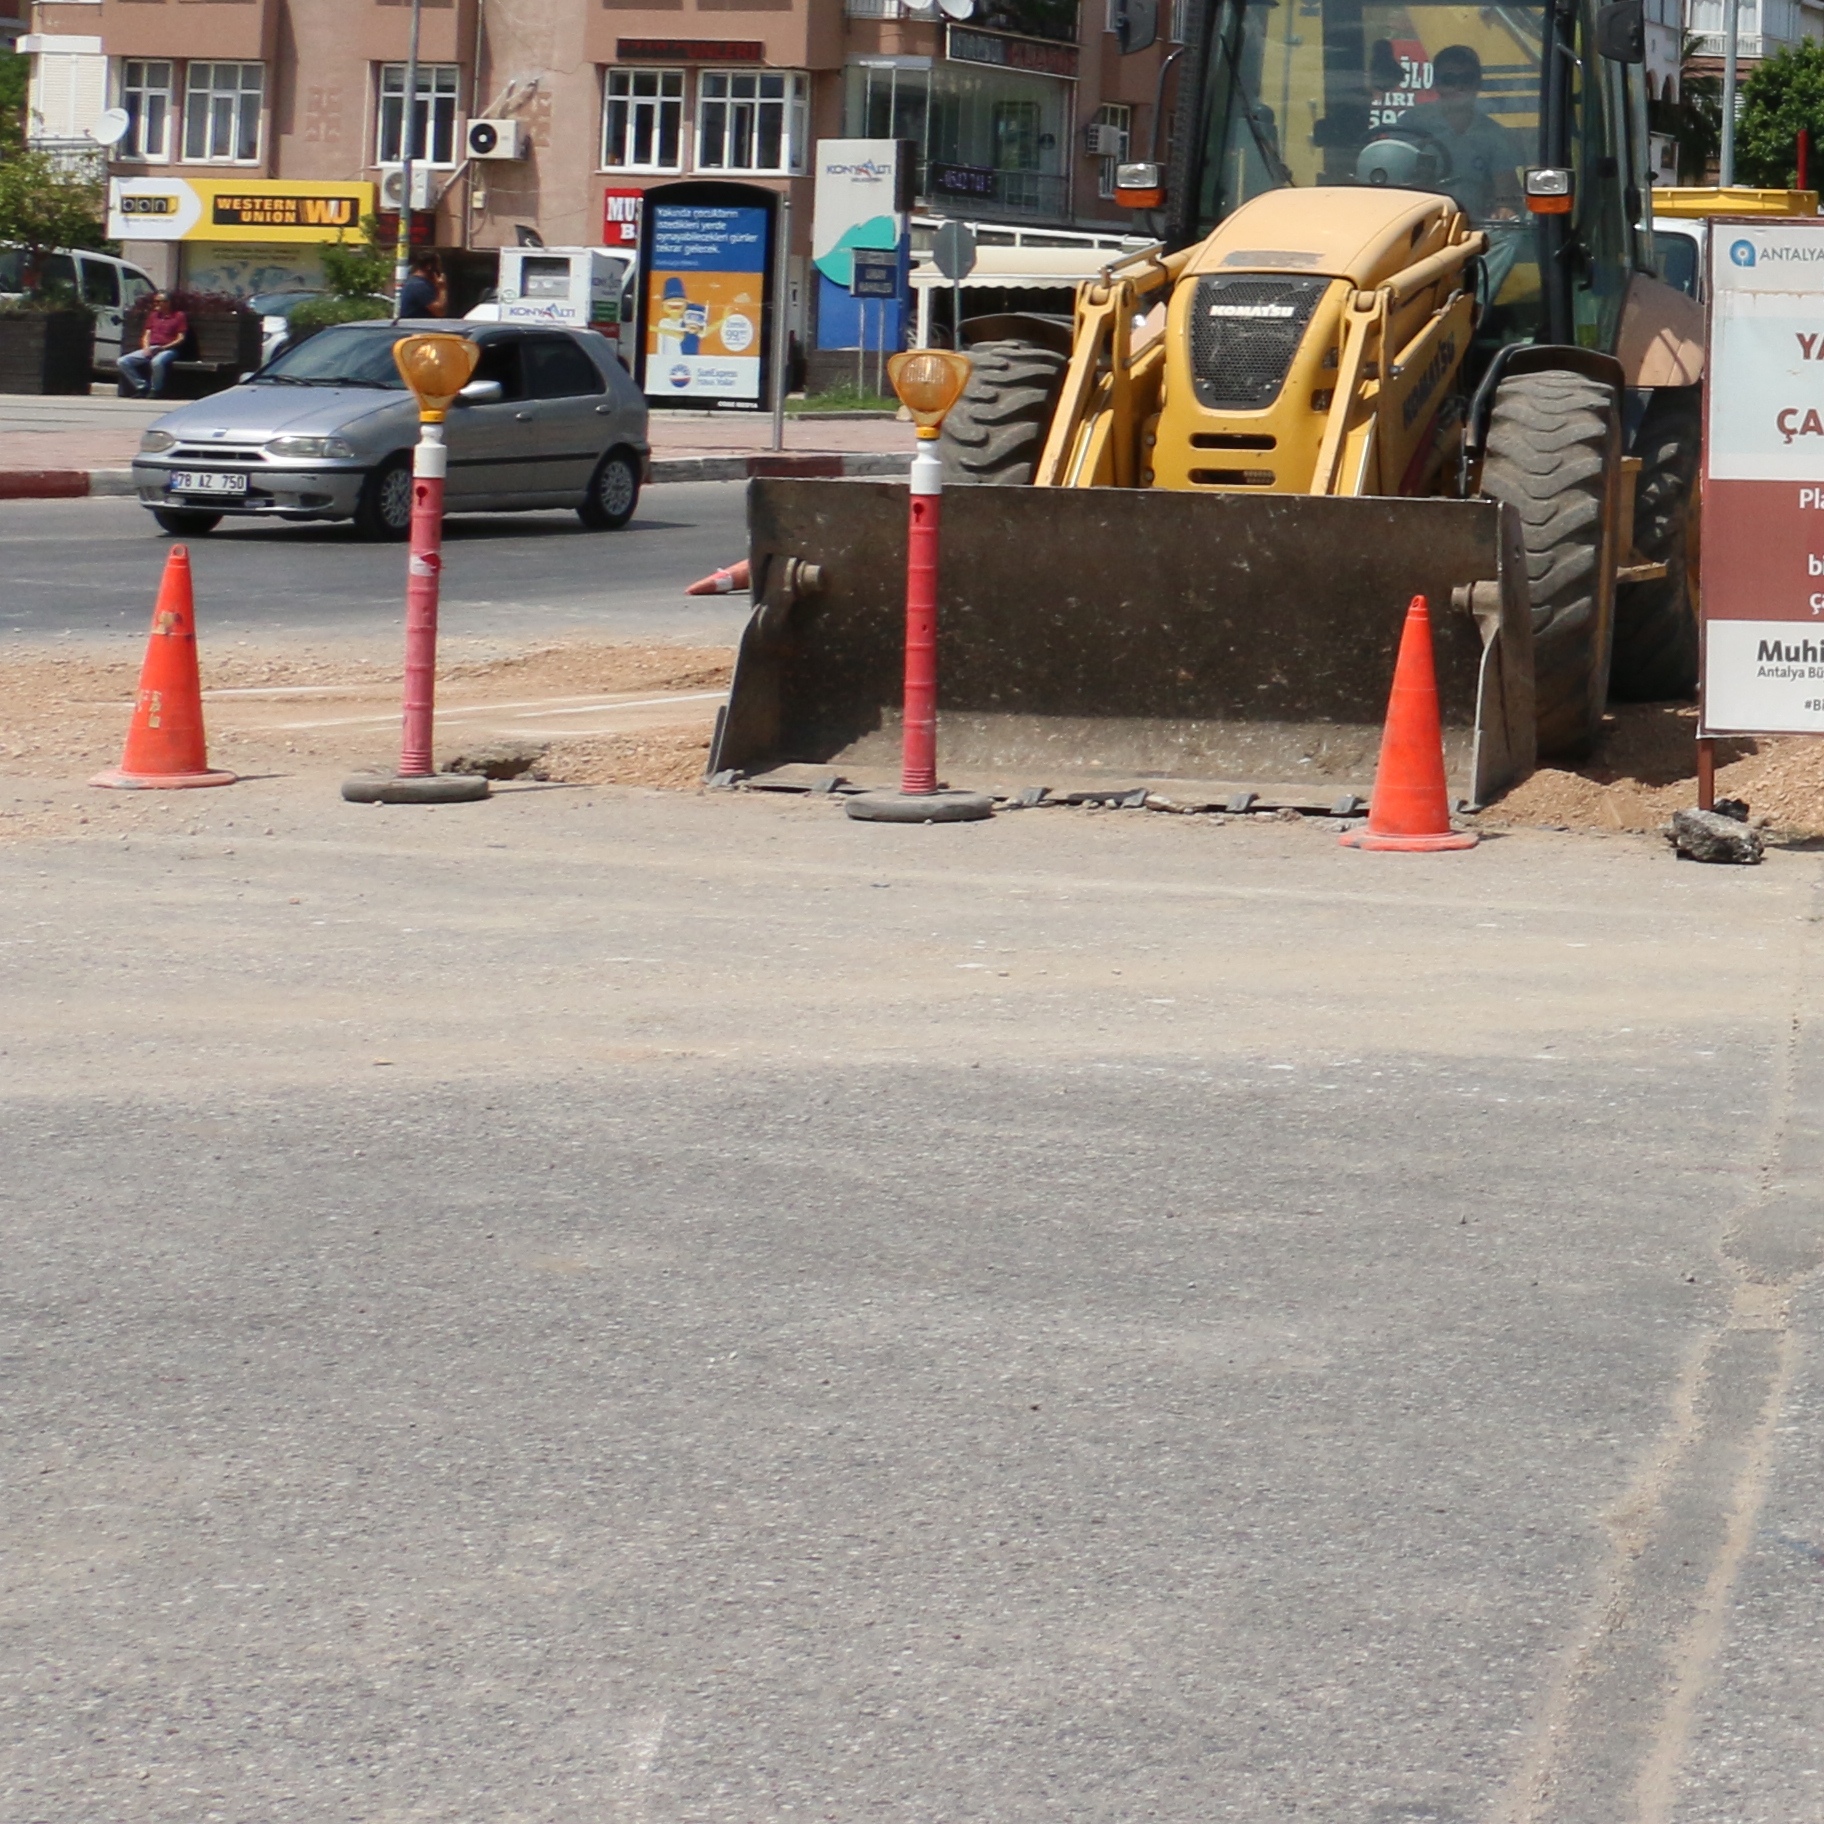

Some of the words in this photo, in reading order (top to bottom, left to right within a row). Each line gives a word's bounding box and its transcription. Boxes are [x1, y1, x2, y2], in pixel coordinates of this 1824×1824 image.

[121, 197, 168, 214] bpn
[216, 198, 297, 210] WESTERN
[240, 210, 296, 222] UNION
[306, 200, 350, 224] WU
[656, 207, 692, 217] Yakında
[700, 221, 727, 231] yerde
[656, 244, 683, 253] tekrar
[1209, 303, 1295, 317] KOMATSU
[178, 473, 192, 487] 78
[199, 474, 213, 488] AZ
[222, 475, 245, 489] 750
[1757, 665, 1805, 682] Antalya
